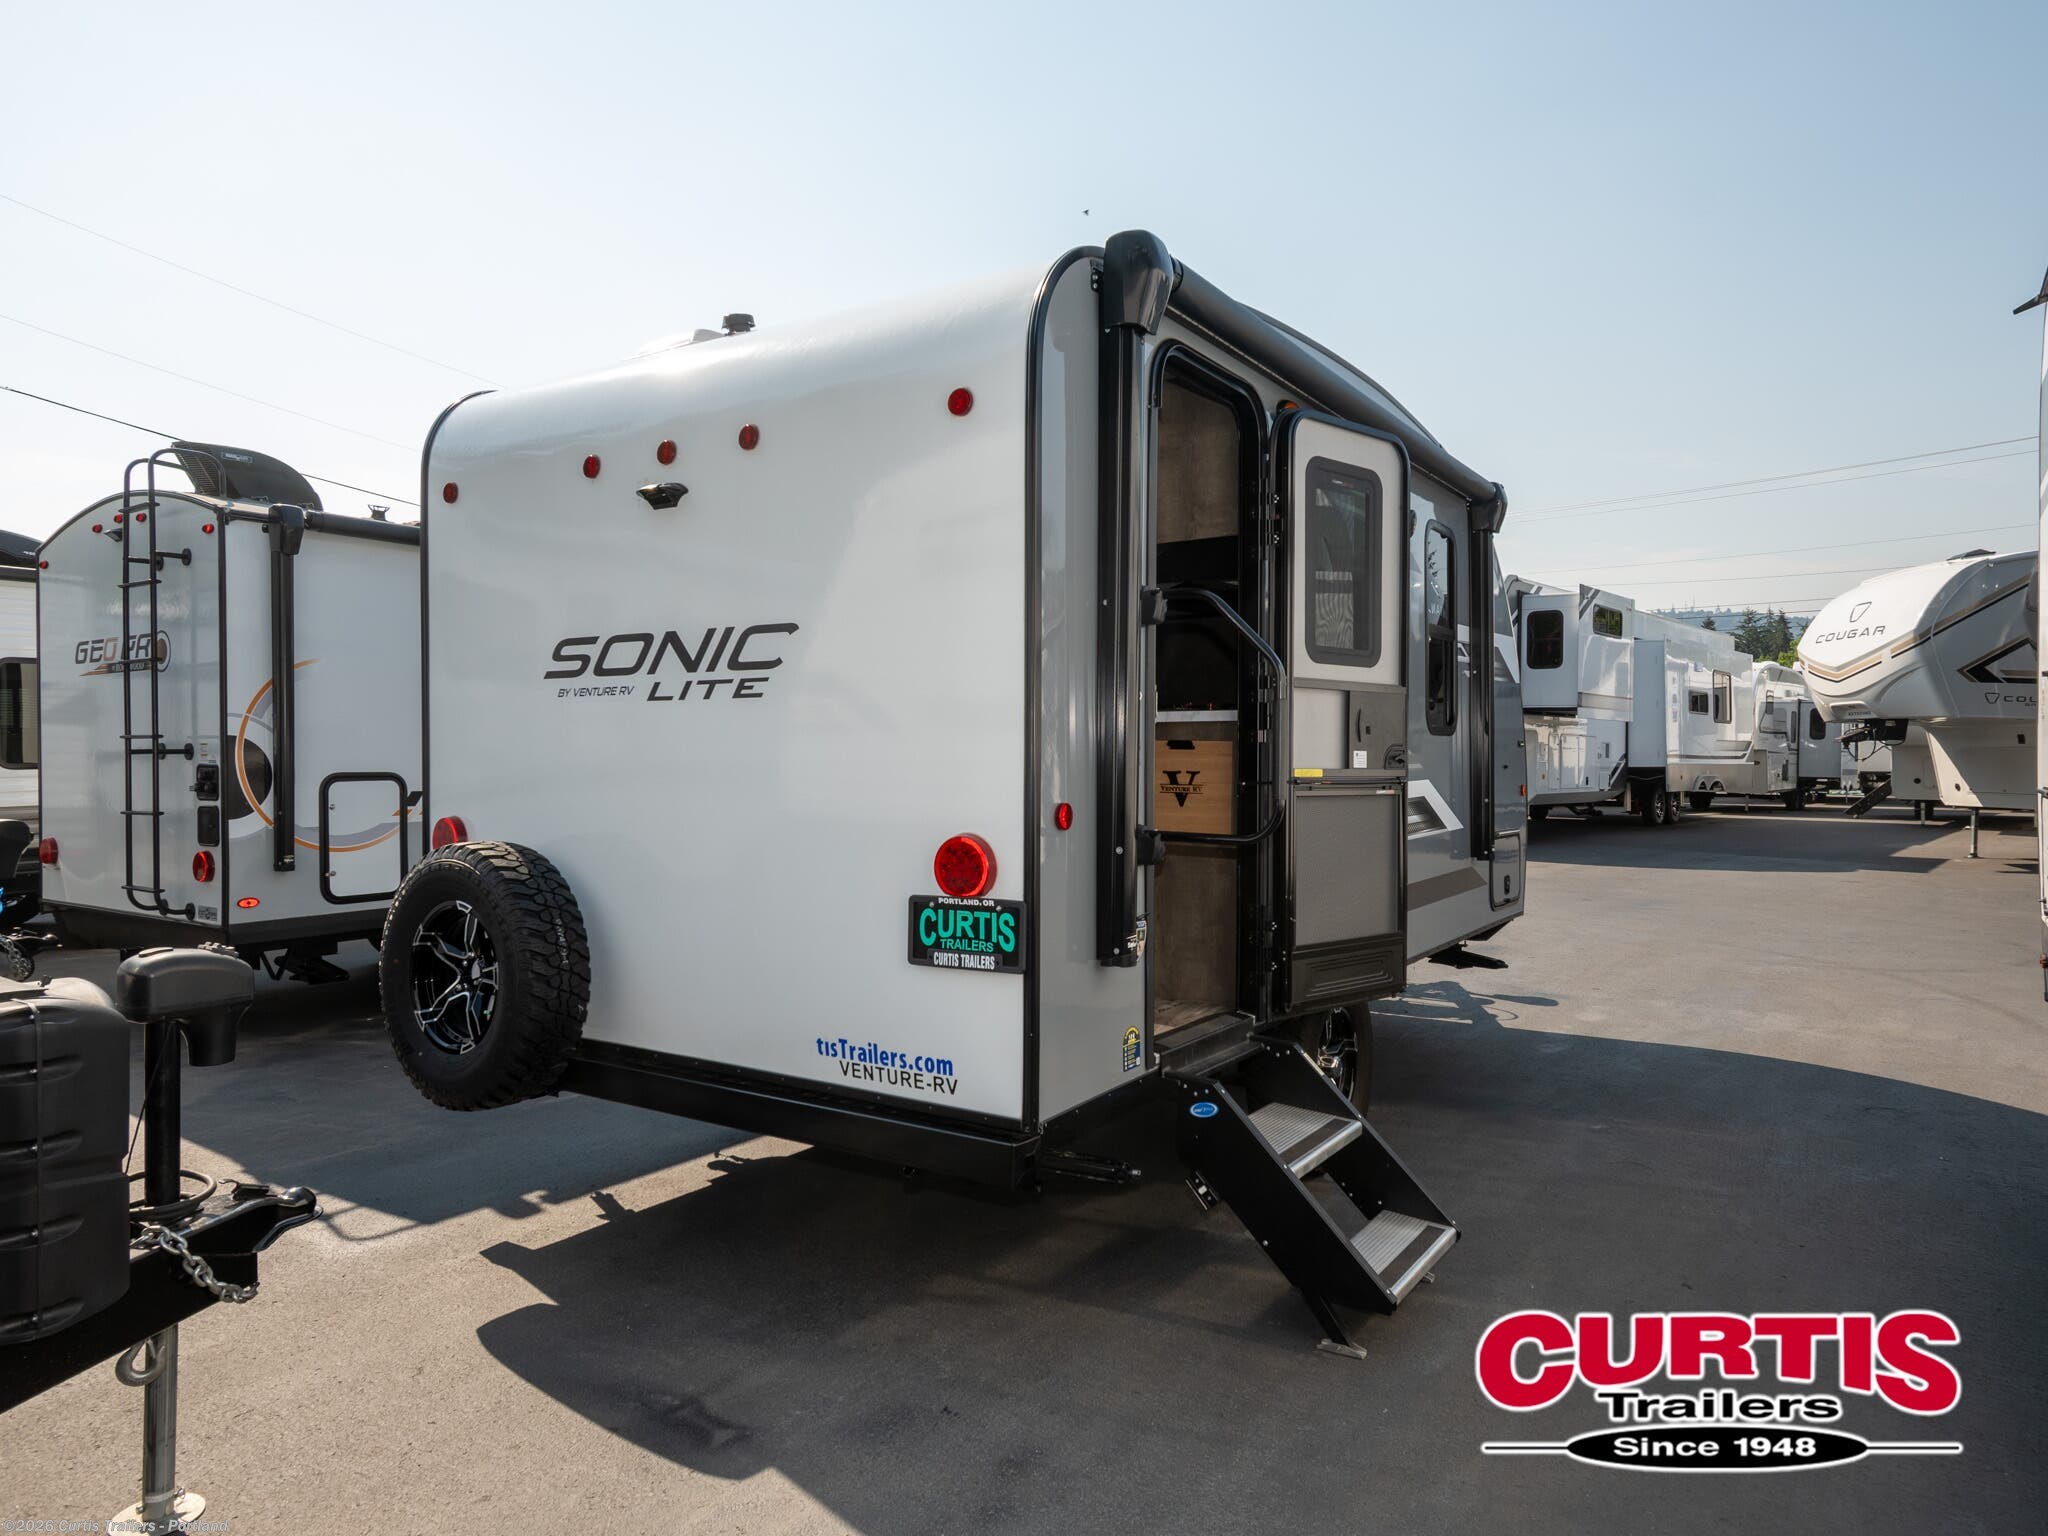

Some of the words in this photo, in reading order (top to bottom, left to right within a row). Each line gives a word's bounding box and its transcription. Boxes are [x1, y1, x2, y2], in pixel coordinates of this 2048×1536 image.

[1815, 625, 1886, 644] COUGAR
[75, 637, 120, 665] GEO
[544, 622, 800, 680] SONIC
[557, 688, 571, 698] BY
[573, 686, 617, 698] VENTURE
[618, 685, 635, 696] RV
[646, 677, 770, 702] LITE
[919, 908, 1016, 952] CURTIS
[940, 938, 994, 953] TRAILERS
[933, 952, 959, 967] CURTIS
[961, 954, 995, 970] TRAILERS
[816, 1037, 954, 1077] tisTrailers.com
[839, 1060, 958, 1095] VENTURE-RV
